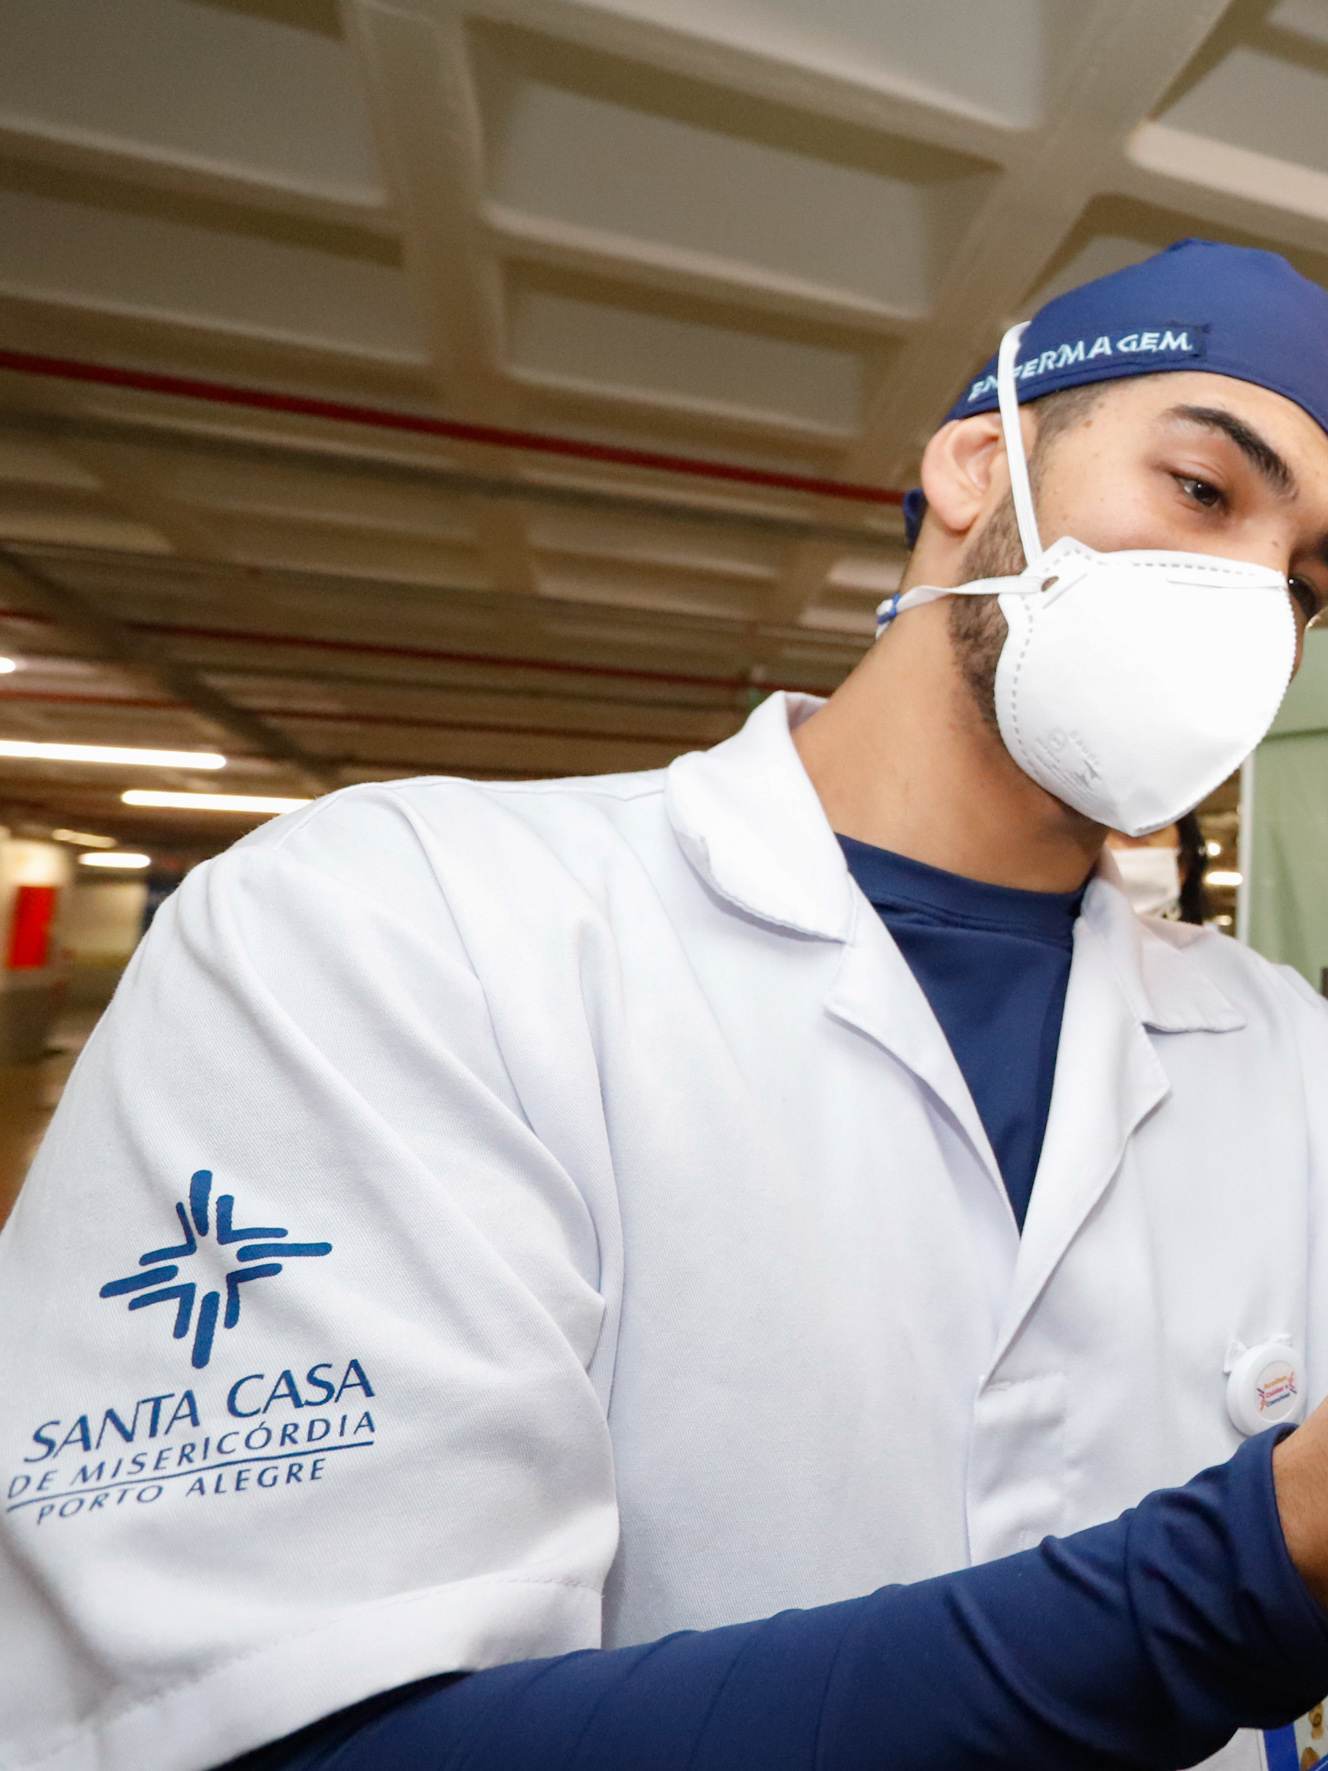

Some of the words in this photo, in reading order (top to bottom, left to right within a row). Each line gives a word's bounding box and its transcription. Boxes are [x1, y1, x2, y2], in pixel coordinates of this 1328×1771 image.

[24, 1388, 201, 1463] SANTA
[226, 1358, 376, 1419] CASA
[6, 1469, 59, 1500] DE
[69, 1411, 376, 1487] MISERICÓRDIA
[36, 1484, 164, 1525] PORTO
[185, 1457, 327, 1497] ALEGRE
